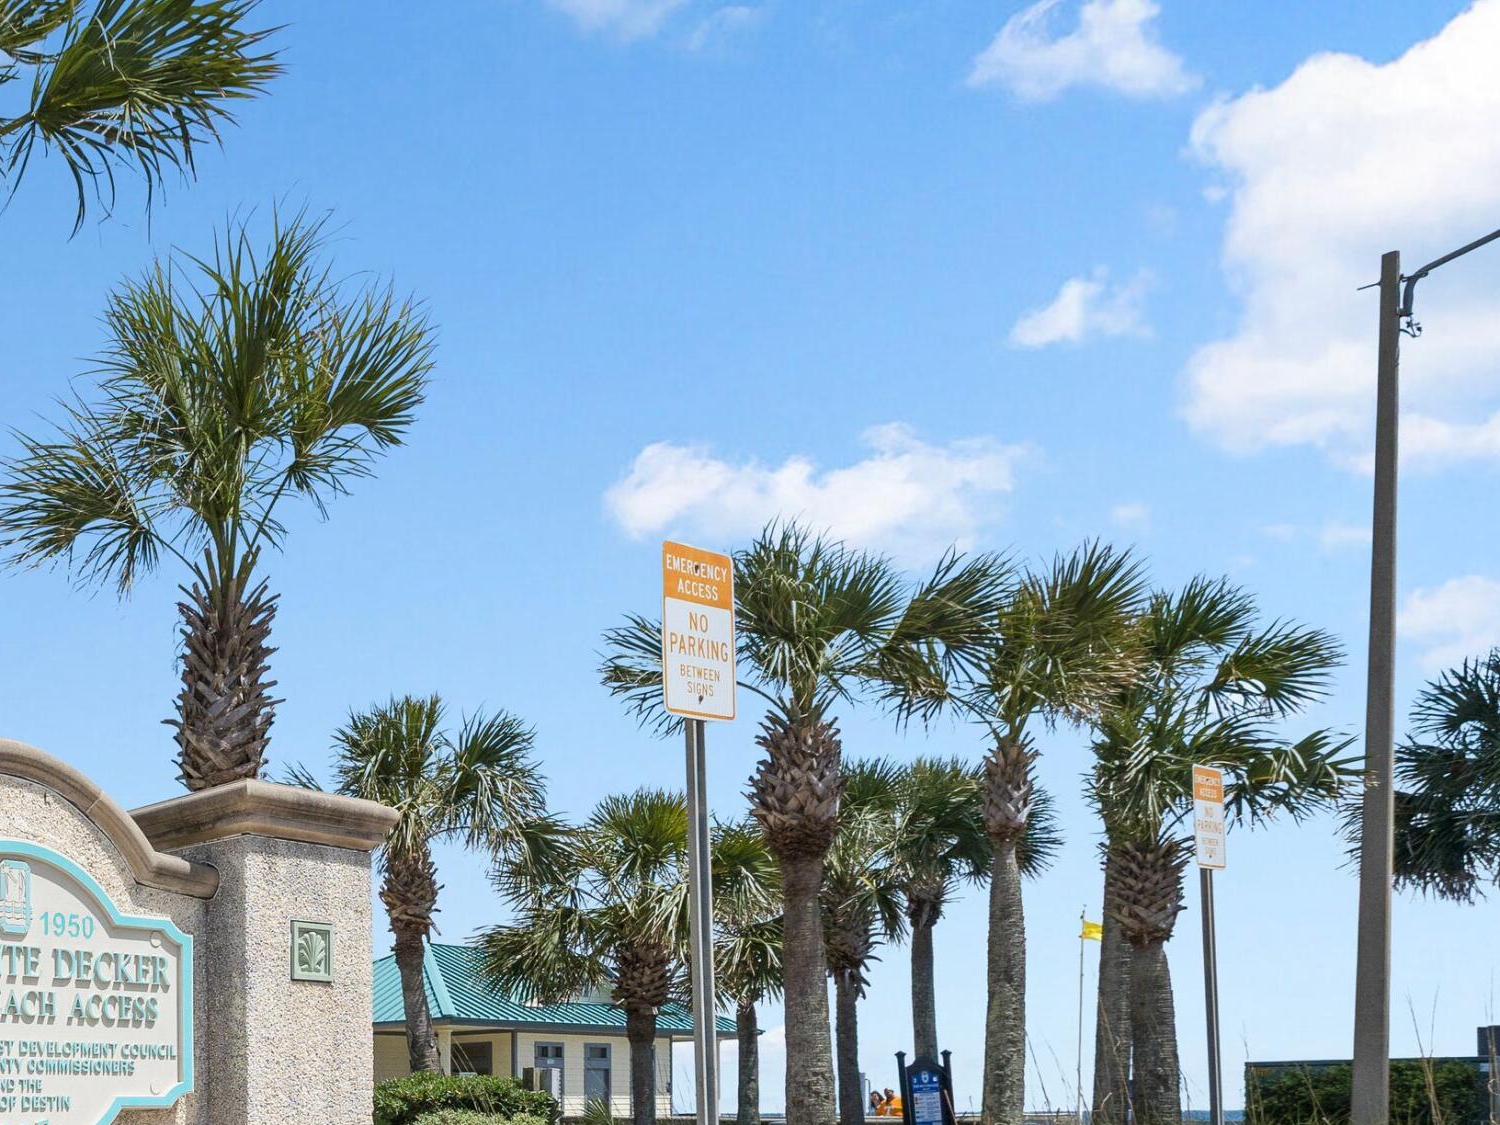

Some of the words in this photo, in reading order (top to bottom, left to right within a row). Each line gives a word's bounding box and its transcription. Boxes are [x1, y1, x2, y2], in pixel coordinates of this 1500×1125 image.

[665, 554, 728, 583] EMERGENCY
[677, 578, 719, 601] ACCESS
[688, 611, 708, 633] NO
[670, 632, 729, 663] PARKING
[680, 663, 720, 682] BETWEEN
[687, 681, 714, 697] SIGNS
[39, 911, 95, 940] 1950
[52, 948, 170, 990] DECKER
[67, 993, 159, 1026] ACCESS
[18, 1040, 118, 1059] DEVELOPMENT
[120, 1043, 178, 1061] COUNCIL
[26, 1059, 136, 1077] COMMISSIONERS
[18, 1079, 43, 1094] THE
[20, 1096, 71, 1113] DESTIN
